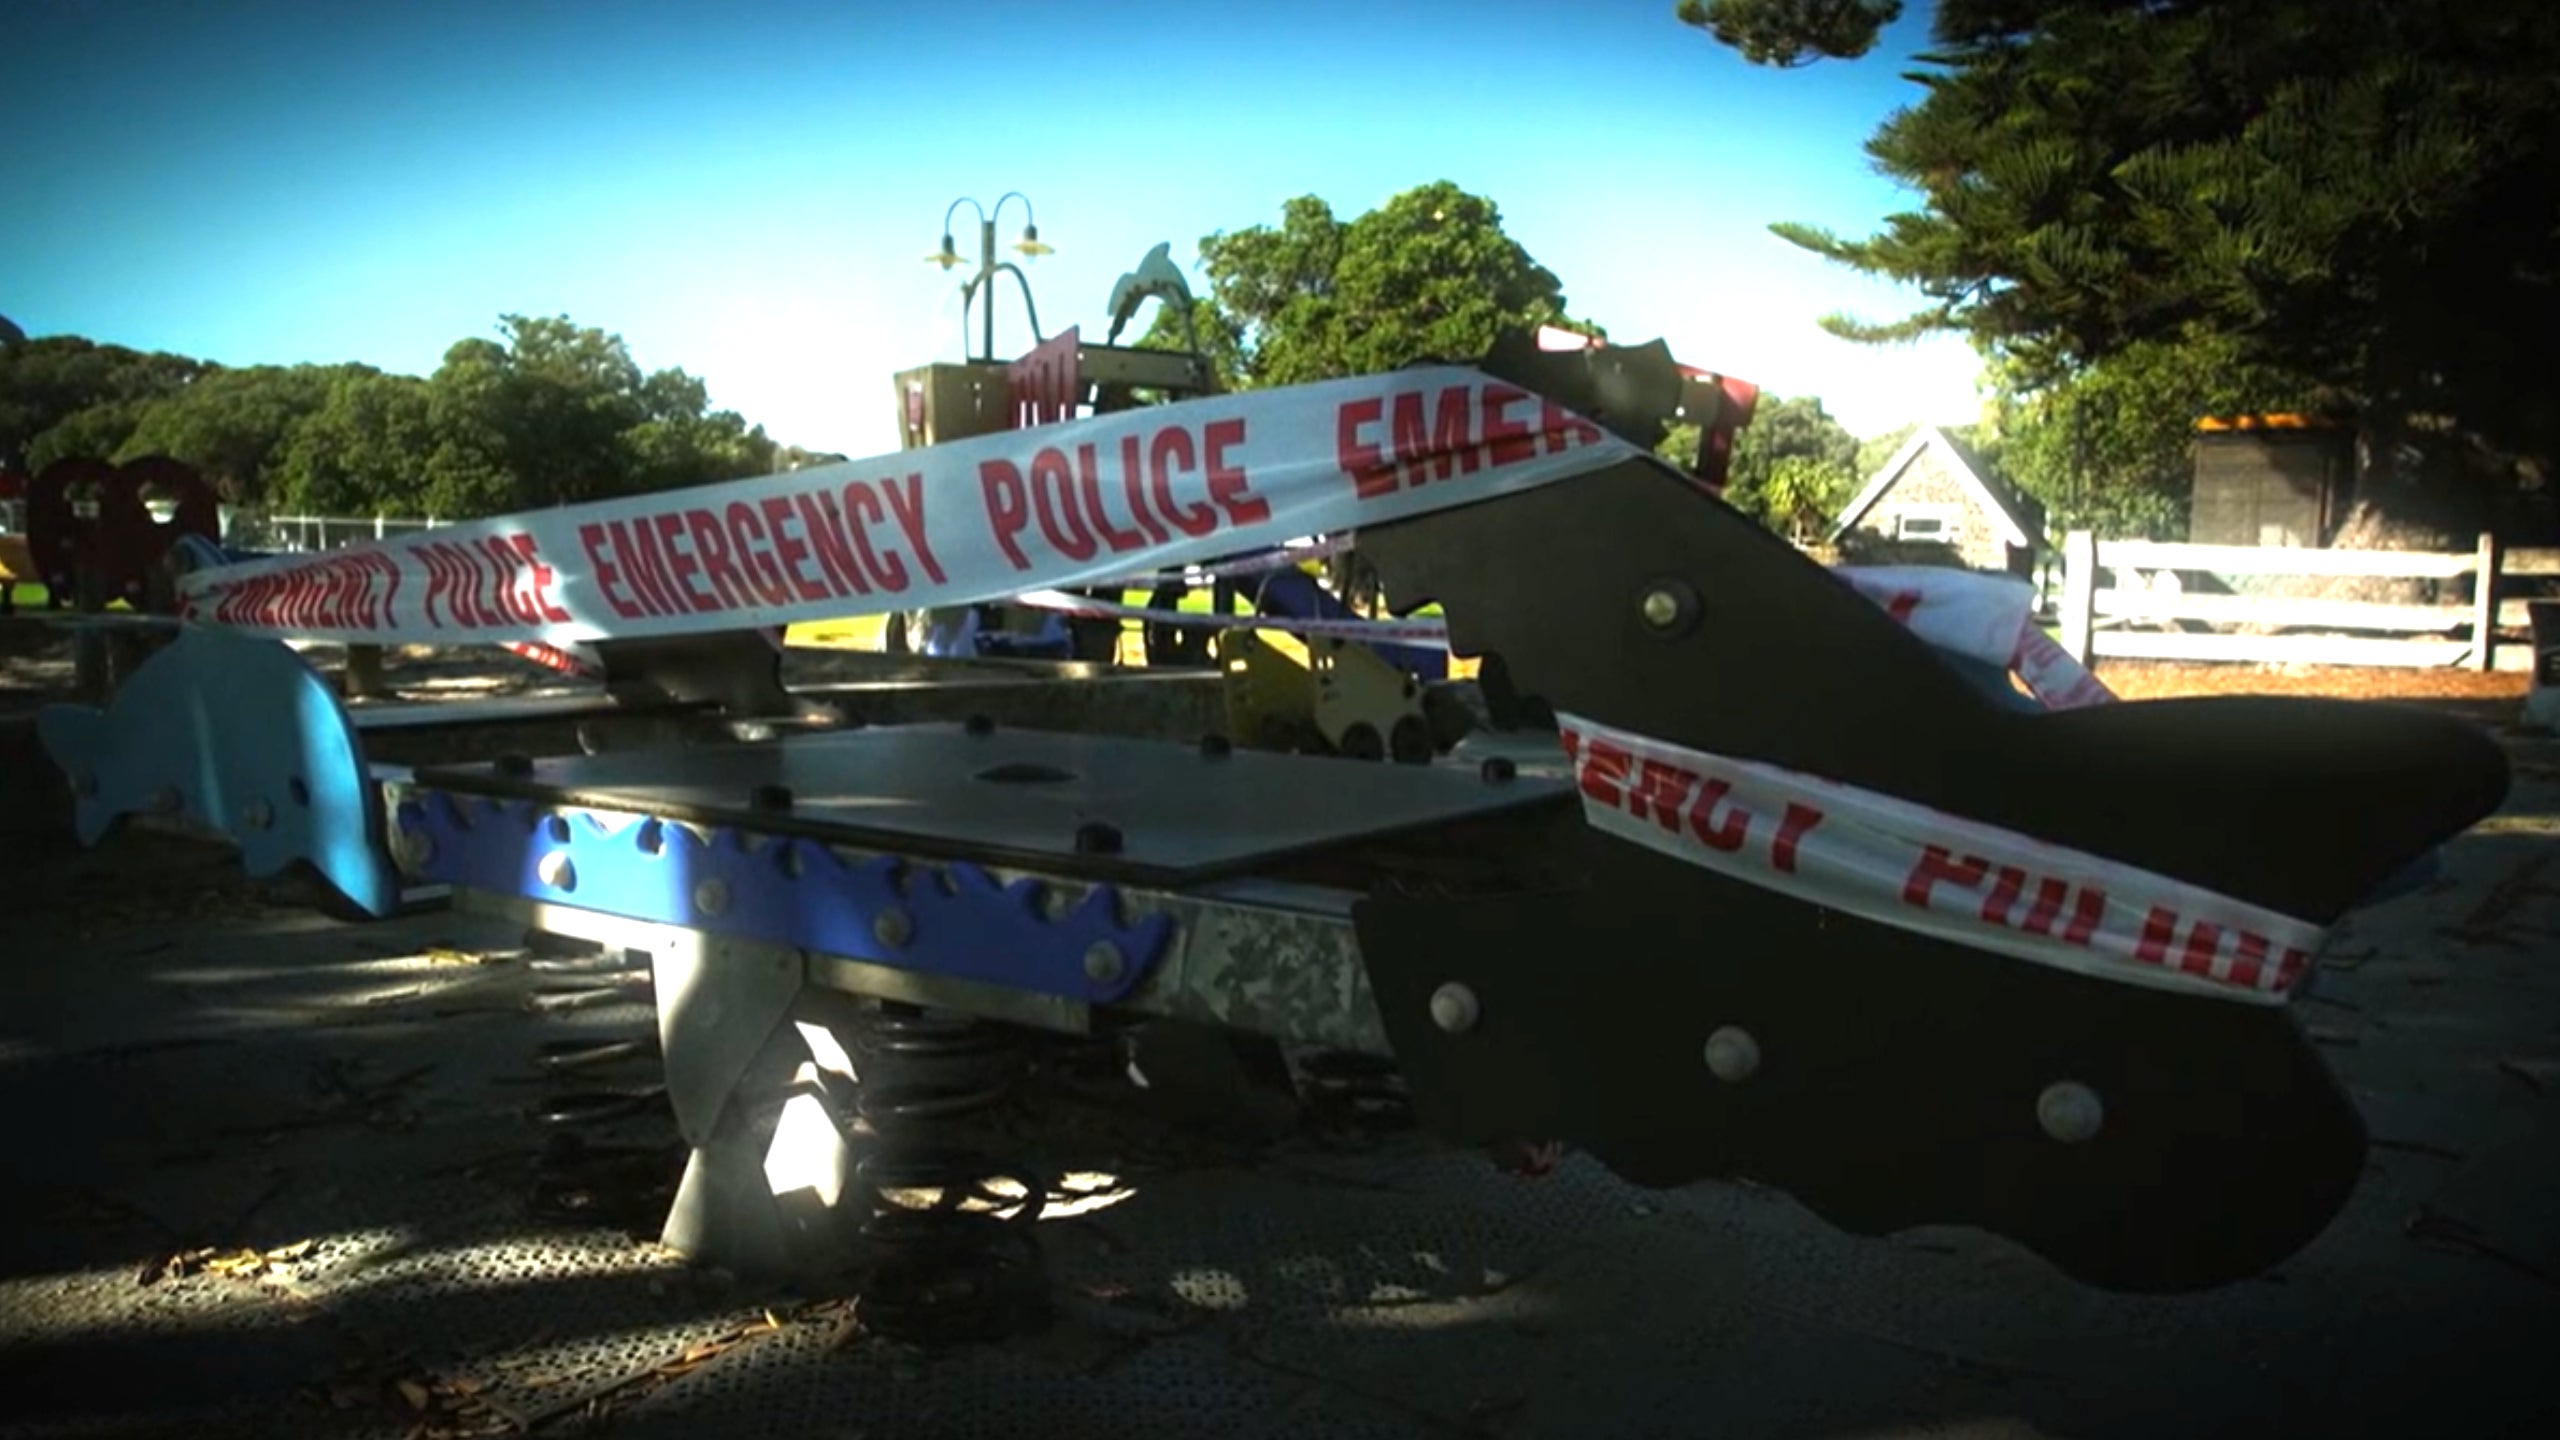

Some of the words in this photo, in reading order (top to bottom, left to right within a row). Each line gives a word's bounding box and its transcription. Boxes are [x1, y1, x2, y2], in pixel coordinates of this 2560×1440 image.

[407, 533, 572, 629] POLICE
[578, 472, 948, 620] EMERGENCY
[979, 419, 1271, 571] POLICE
